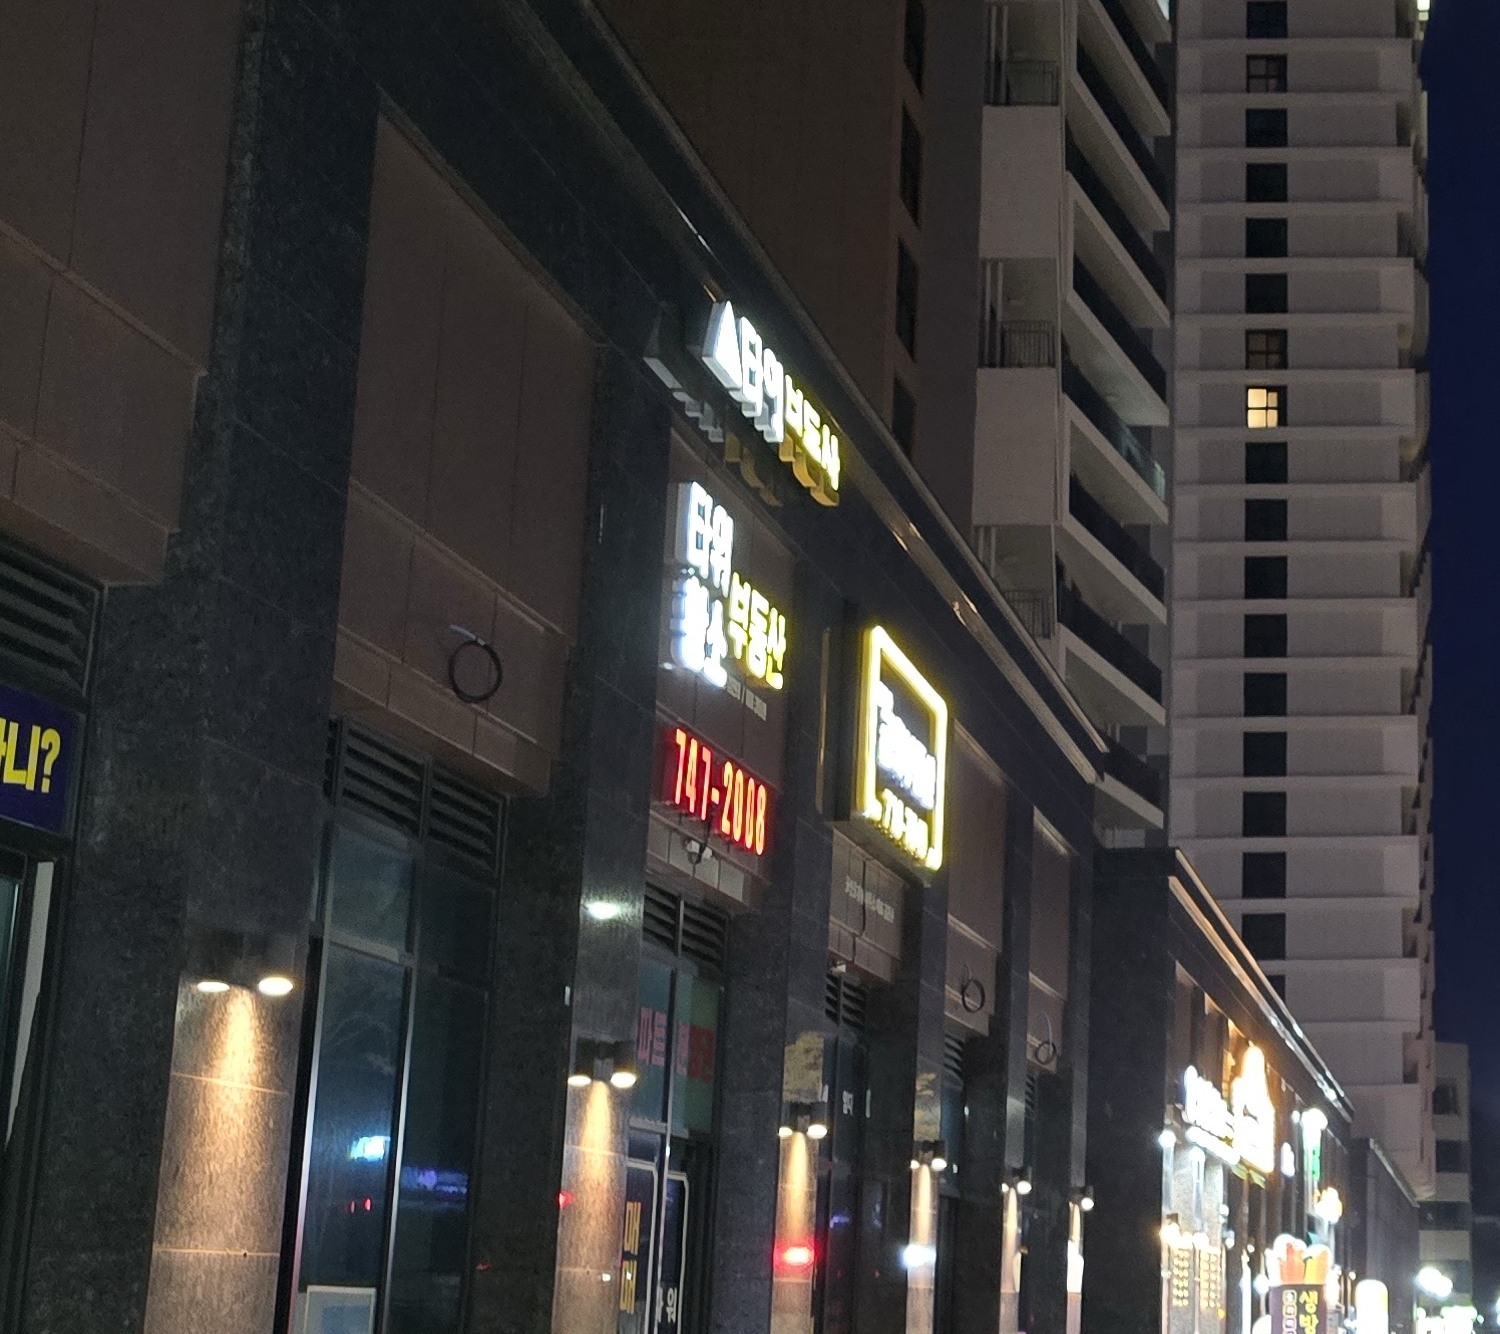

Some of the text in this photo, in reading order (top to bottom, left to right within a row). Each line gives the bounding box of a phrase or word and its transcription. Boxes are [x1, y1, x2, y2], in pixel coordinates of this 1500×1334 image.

[728, 571, 787, 690] 부동산
[0, 716, 61, 793] 니?
[674, 728, 768, 856] 747-2008
